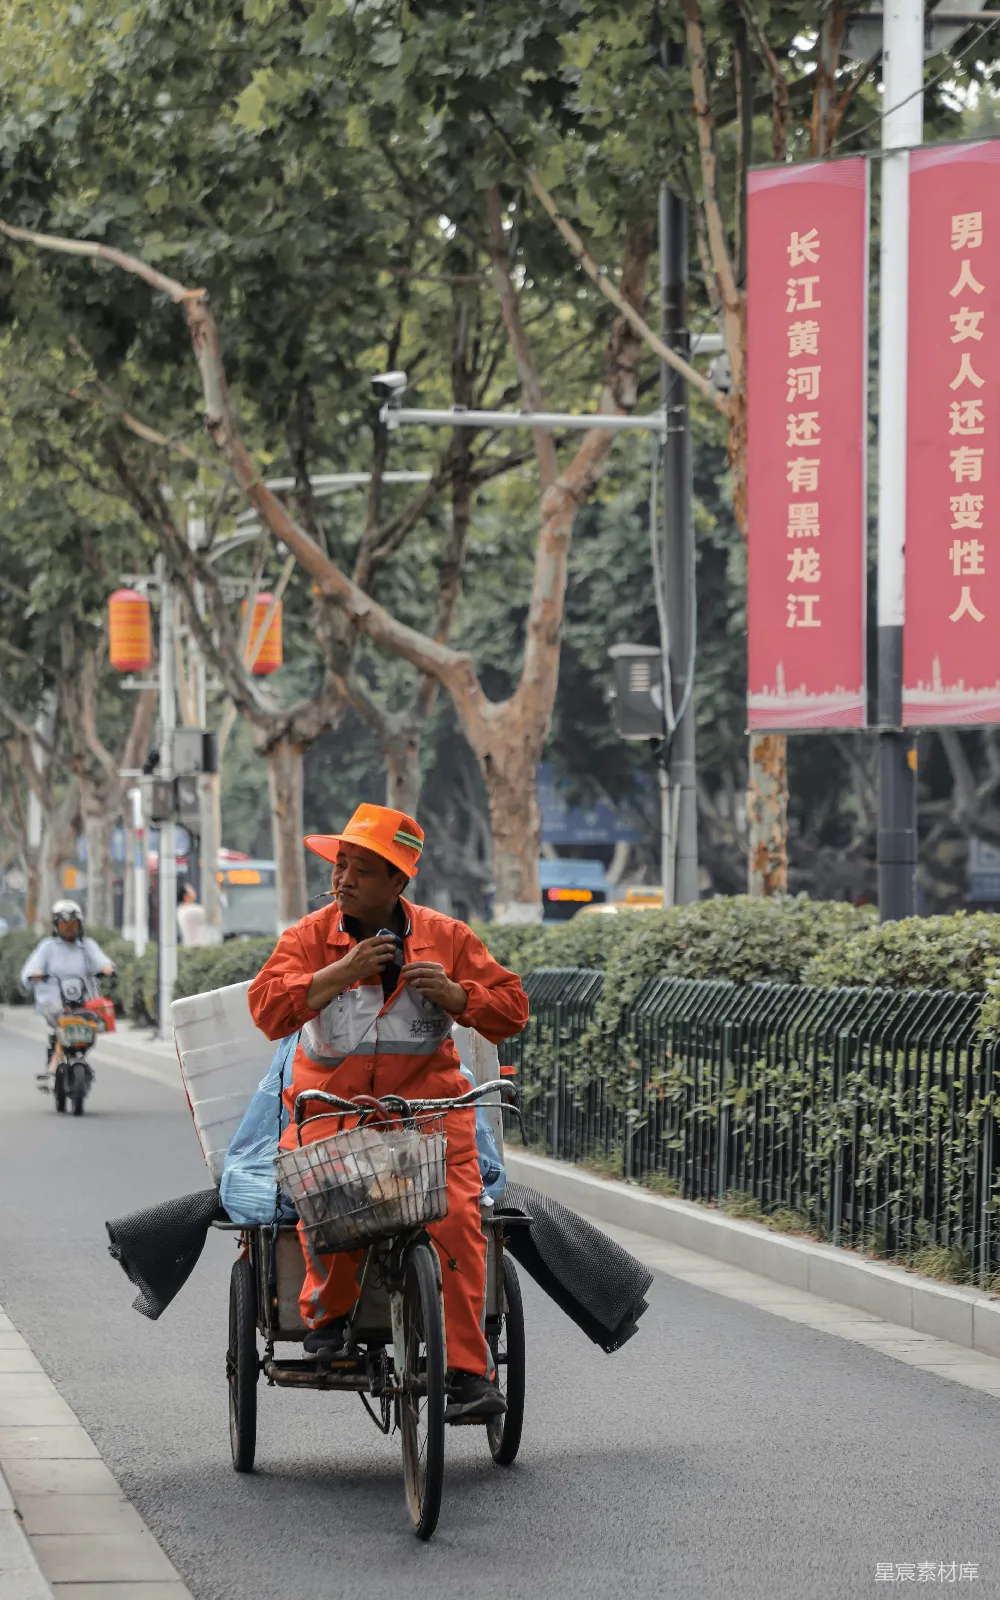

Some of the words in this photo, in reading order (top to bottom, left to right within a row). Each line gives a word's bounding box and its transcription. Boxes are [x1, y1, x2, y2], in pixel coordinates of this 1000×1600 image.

[786, 228, 821, 628] 长江黄河还有黑龙江
[949, 212, 985, 623] 男人女人还有变性人
